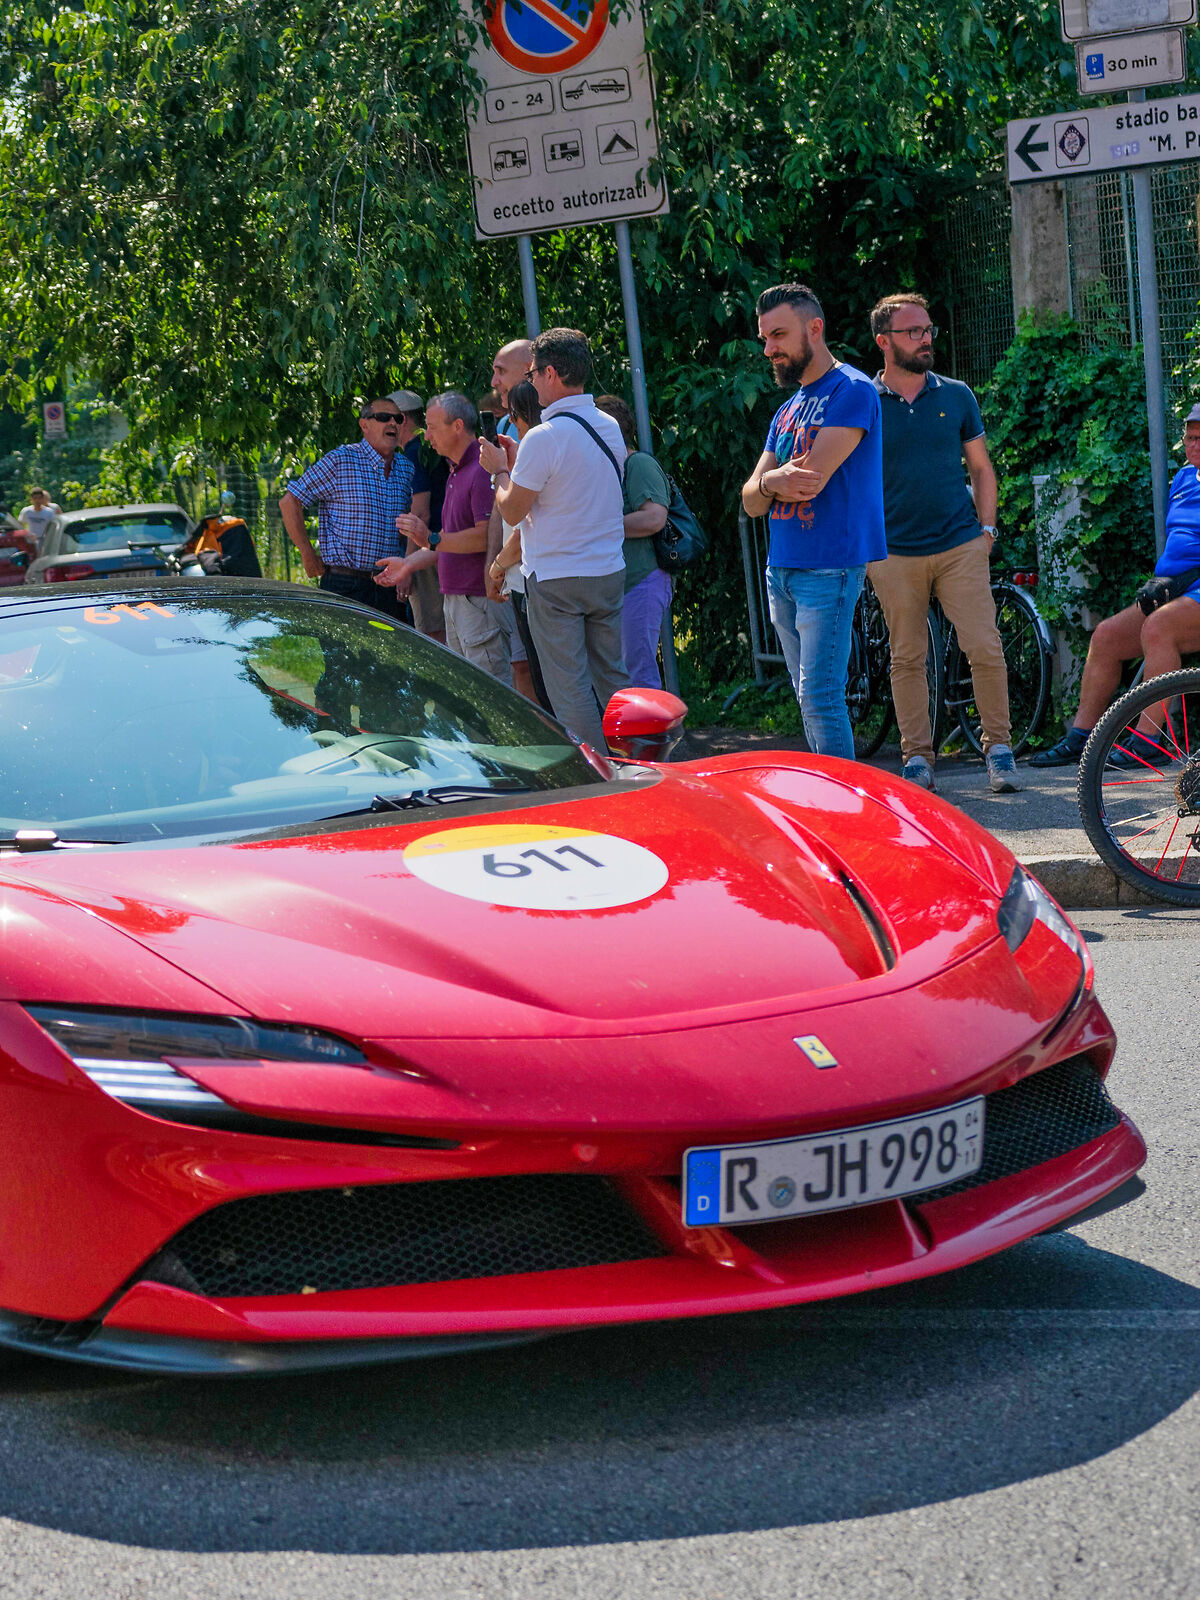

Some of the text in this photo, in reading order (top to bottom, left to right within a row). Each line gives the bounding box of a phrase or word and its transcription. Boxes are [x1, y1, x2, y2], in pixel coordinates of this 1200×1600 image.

[1107, 55, 1157, 72] 30 min
[494, 99, 505, 111] 0
[526, 93, 544, 107] 24
[1115, 103, 1198, 130] stadio ba
[493, 181, 647, 220] eccetto autorizzati
[84, 601, 176, 625] 611
[482, 845, 606, 878] 611
[725, 1156, 760, 1213] R
[697, 1195, 710, 1211] D
